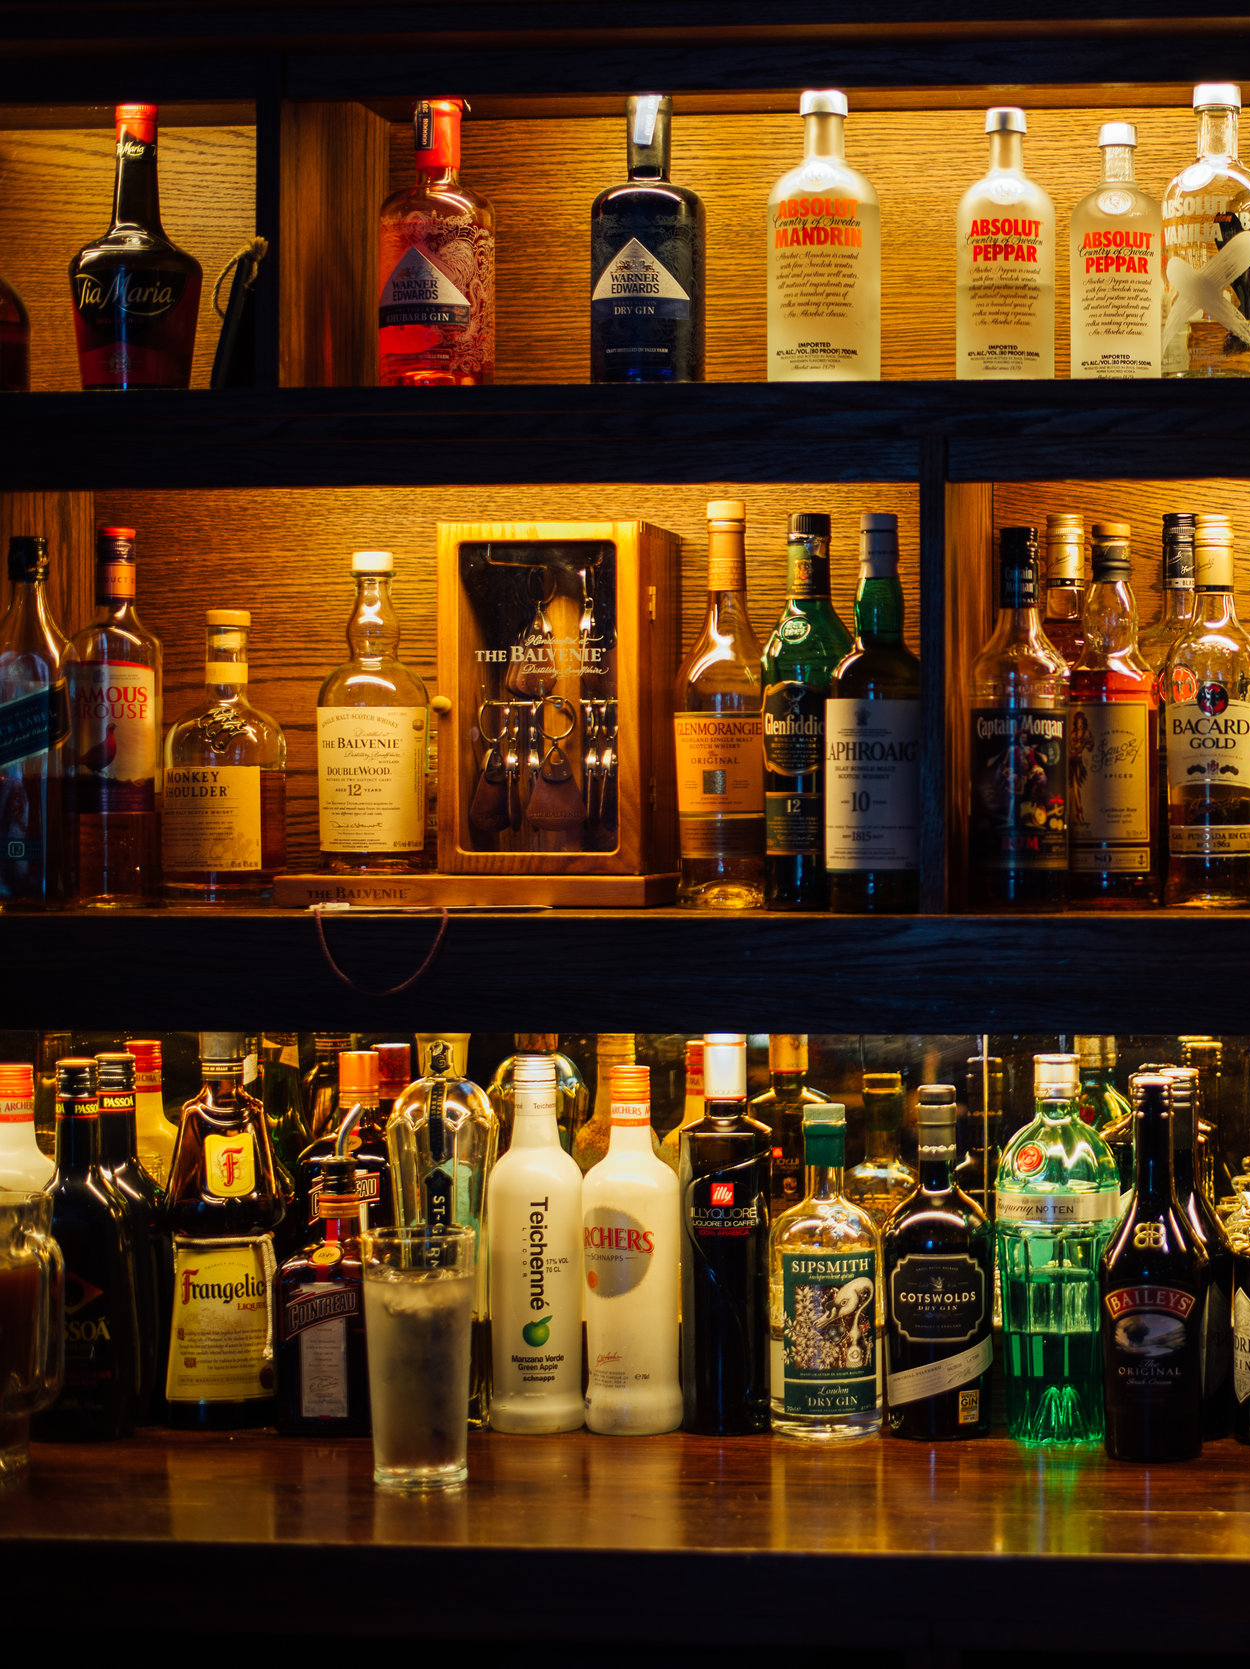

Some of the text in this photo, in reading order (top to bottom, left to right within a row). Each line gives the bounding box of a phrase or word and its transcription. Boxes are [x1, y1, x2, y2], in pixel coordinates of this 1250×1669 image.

[778, 198, 860, 220] ABSOLUT
[1162, 196, 1229, 221] ABSOLUT
[773, 214, 861, 231] Country of Sweden
[970, 218, 1041, 238] ABSOLUT
[774, 226, 863, 249] MANDRIN
[1083, 231, 1154, 250] ABSOLUT
[1163, 222, 1224, 246] VANILIA
[972, 244, 1038, 263] PEPPAR
[1085, 256, 1149, 275] PEPPAR
[393, 278, 439, 290] WARNER
[610, 272, 660, 284] WARNER
[99, 273, 174, 309] Maria
[393, 289, 439, 301] EDWARDS
[611, 282, 660, 294] EDWARDS
[429, 311, 450, 322] GIN
[614, 306, 656, 315] DRY GIN
[475, 645, 602, 663] THE BALVENIE
[677, 722, 763, 736] GLENMORANGIE
[765, 713, 825, 736] Glenfiddic
[977, 714, 1064, 740] Captain Morgan
[322, 737, 400, 749] THE BALVENIE
[1190, 736, 1236, 750] GOLD
[691, 757, 740, 765] ORIGINAL
[167, 771, 220, 784] MONKEY
[327, 766, 391, 777] DOUBLEWOOD
[165, 785, 228, 798] SHOULDER
[785, 798, 802, 814] 12
[851, 791, 870, 813] 10
[852, 831, 872, 842] 1815
[1000, 835, 1040, 852] RUM
[307, 886, 407, 900] THE BALVENIE
[611, 1105, 643, 1117] ARCHERS
[712, 1183, 733, 1202] illy
[690, 1205, 757, 1219] ILLYQUORE
[1051, 1205, 1074, 1214] TEN
[692, 1218, 722, 1227] LIQUORE
[723, 1218, 731, 1226] DI
[584, 1226, 656, 1253] RCHERS
[530, 1196, 550, 1312] Teichenné
[590, 1253, 624, 1262] SCHNAPPS
[545, 1257, 569, 1266] 17% VOL
[791, 1257, 870, 1274] SIPSMITH
[545, 1265, 562, 1274] 70 CL
[899, 1290, 977, 1304] COTSWOLDS
[1111, 1291, 1190, 1312] BAILEYS
[287, 1288, 359, 1335] COINTREAU
[511, 1353, 565, 1363] Manzana Verde
[518, 1361, 559, 1372] Green Apple
[1118, 1366, 1182, 1376] ORIGINAL
[522, 1373, 556, 1384] schnapps
[816, 1384, 850, 1396] London
[807, 1396, 858, 1408] DRY GIN
[960, 1397, 978, 1407] GIN
